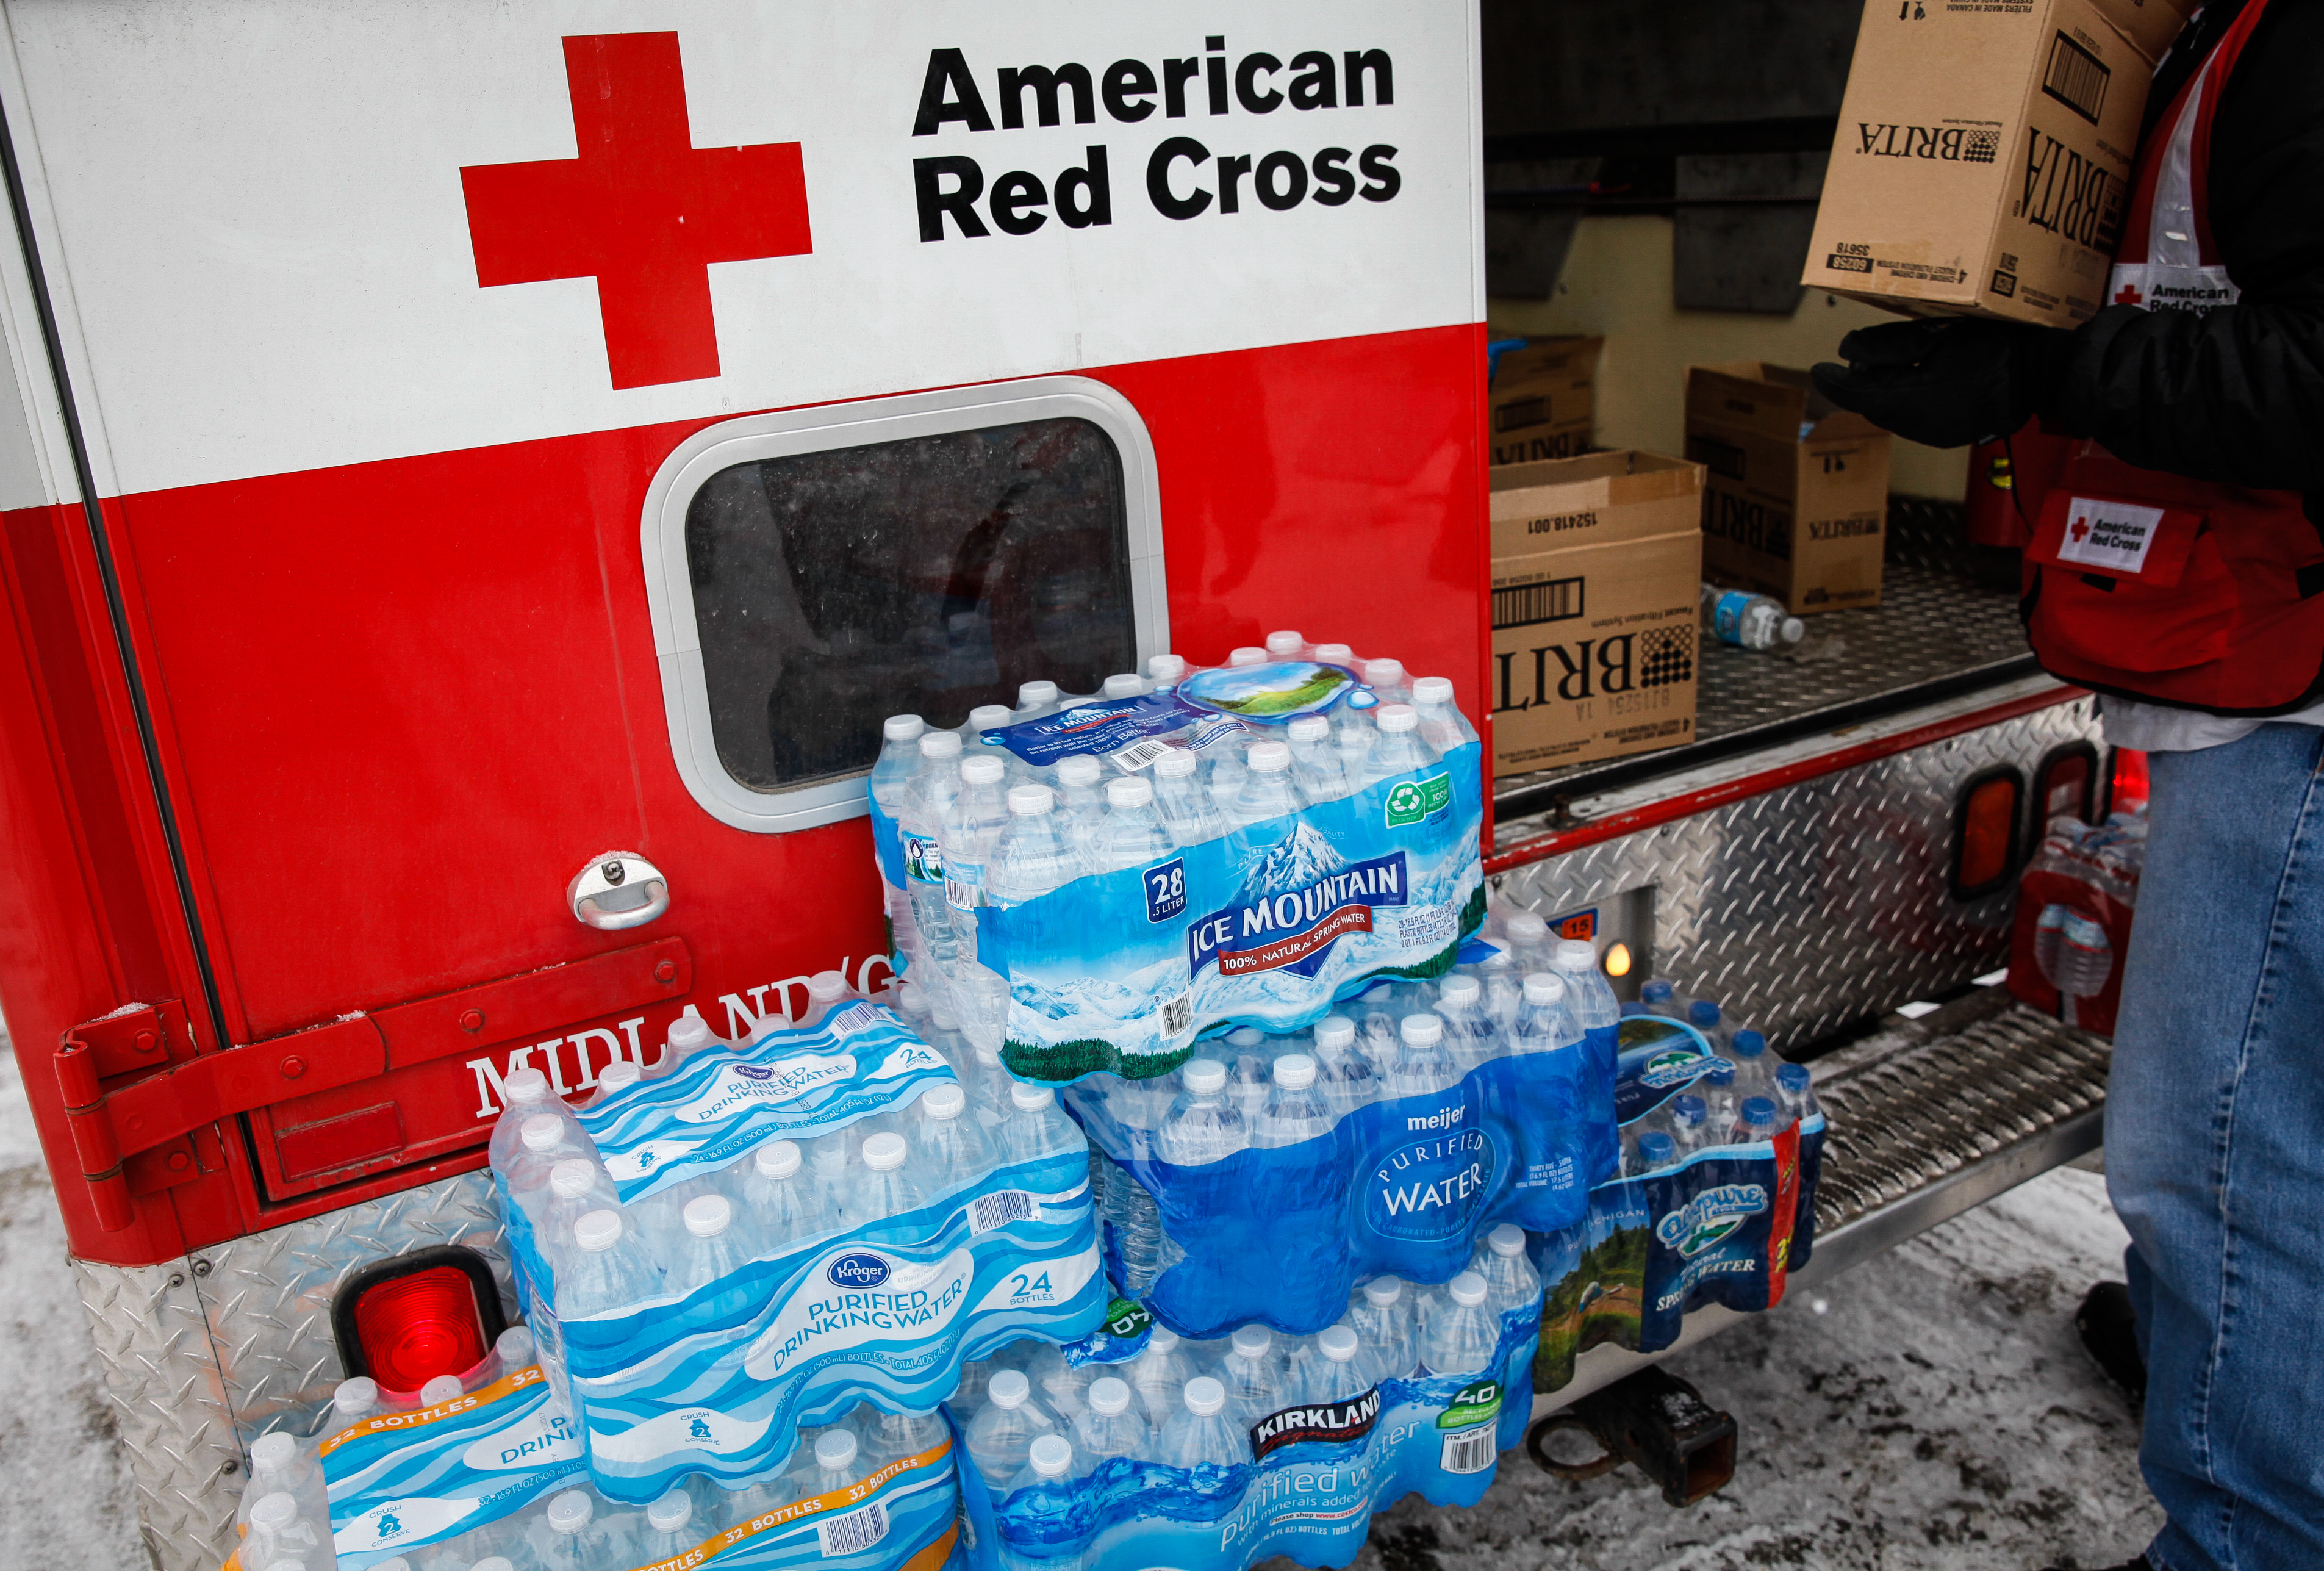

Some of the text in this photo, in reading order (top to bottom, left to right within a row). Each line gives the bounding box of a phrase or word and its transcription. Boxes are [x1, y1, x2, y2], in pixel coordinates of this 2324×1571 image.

[911, 34, 1394, 137] American
[1857, 123, 1967, 161] BRITA
[913, 136, 1402, 243] Red Cross
[2020, 126, 2109, 250] BRITA
[1836, 242, 1870, 256] 35618
[1832, 256, 1868, 271] 60258
[2152, 284, 2229, 300] American
[1527, 511, 1598, 534] 152418.001
[2093, 519, 2146, 537] American
[2089, 532, 2142, 552] Red Cross
[1591, 616, 1623, 628] System
[1492, 633, 1637, 714] BRIT
[1041, 724, 1065, 733] ICE
[1063, 707, 1137, 727] MOUNTAIN
[1026, 744, 1047, 752] Better
[1072, 733, 1096, 742] nature.
[1039, 744, 1063, 754] refresh
[1088, 733, 1105, 742] water
[1068, 741, 1095, 750] selected
[1092, 740, 1120, 752] Born
[1117, 728, 1151, 741] Better.
[1205, 731, 1225, 744] particularly
[1238, 847, 1263, 870] PURE
[1151, 867, 1183, 905] 28
[1152, 896, 1185, 917] .5 LITER
[1192, 915, 1234, 962] ICE
[1241, 862, 1399, 938] MOUNTAIN
[1415, 916, 1420, 925] FL
[1419, 915, 1426, 924] OZ
[1569, 918, 1589, 935] 15
[1223, 912, 1366, 970] 100% NATURAL SPRING WATER
[1399, 927, 1417, 939] PLASTIC
[1416, 923, 1433, 935] BOTTLES
[900, 1048, 933, 1066] 24
[905, 1057, 938, 1069] BOTTLES
[726, 1066, 807, 1093] PURIFIED
[738, 1065, 770, 1080] Kroger
[698, 1087, 789, 1120] DRINKING
[787, 1064, 846, 1090] WATER
[1407, 1104, 1466, 1131] meijer
[692, 1154, 705, 1163] 24
[708, 1148, 723, 1159] 16.9
[723, 1143, 733, 1154] FL
[733, 1137, 745, 1148] OZ
[744, 1127, 764, 1144] (500
[764, 1123, 778, 1134] mL)
[776, 1119, 812, 1131] BOTTLES
[814, 1110, 840, 1124] TOTAL
[838, 1099, 855, 1114] 405
[853, 1098, 864, 1107] FL
[864, 1096, 874, 1105] OZ
[631, 1145, 654, 1160] CRUSH
[643, 1156, 652, 1167] 2
[1377, 1132, 1483, 1183] PURIFIED
[636, 1156, 662, 1174] CONSERVE
[1382, 1162, 1483, 1217] WATER
[986, 1220, 1005, 1231] 11110
[1383, 1217, 1466, 1236] CARBONATED PURITY
[1591, 1209, 1646, 1229] ICHIGAN
[837, 1259, 883, 1284] Kroger
[1698, 1258, 1756, 1279] WATER
[1010, 1270, 1053, 1298] 24
[809, 1290, 928, 1321] PURIFIED
[1010, 1293, 1055, 1306] BOTTLES
[773, 1279, 958, 1372] DRINKING WATER
[795, 1374, 803, 1388] FL
[803, 1366, 814, 1379] OZ
[813, 1356, 832, 1372] (500
[832, 1353, 847, 1363] mL)
[847, 1351, 884, 1364] BOTTLES
[889, 1357, 917, 1371] TOTAL
[916, 1353, 933, 1367] 405
[933, 1348, 942, 1361] FL
[941, 1341, 949, 1354] OZ
[511, 1368, 541, 1387] 32
[1454, 1384, 1496, 1404] 40
[329, 1395, 478, 1448] 32 BOTTLES
[680, 1411, 710, 1422] CRUSH
[1257, 1390, 1381, 1445] KIRKLAND
[695, 1426, 707, 1437] 2
[684, 1437, 721, 1447] CONSERVE
[478, 1469, 556, 1507] 32 16.9 FL OZ (500
[1221, 1466, 1339, 1552] purified
[1350, 1418, 1424, 1488] water
[725, 1458, 919, 1544] 32 BOTTLES 32 BOTTLES
[368, 1504, 403, 1520] CRUSH
[1238, 1490, 1360, 1546] with minerals added
[1270, 1512, 1294, 1525] Please
[371, 1528, 411, 1547] CONSERVE
[384, 1522, 396, 1534] 2
[1285, 1526, 1297, 1534] OZ)
[1298, 1525, 1328, 1536] BOTTLES
[1332, 1524, 1351, 1536] TOTAL
